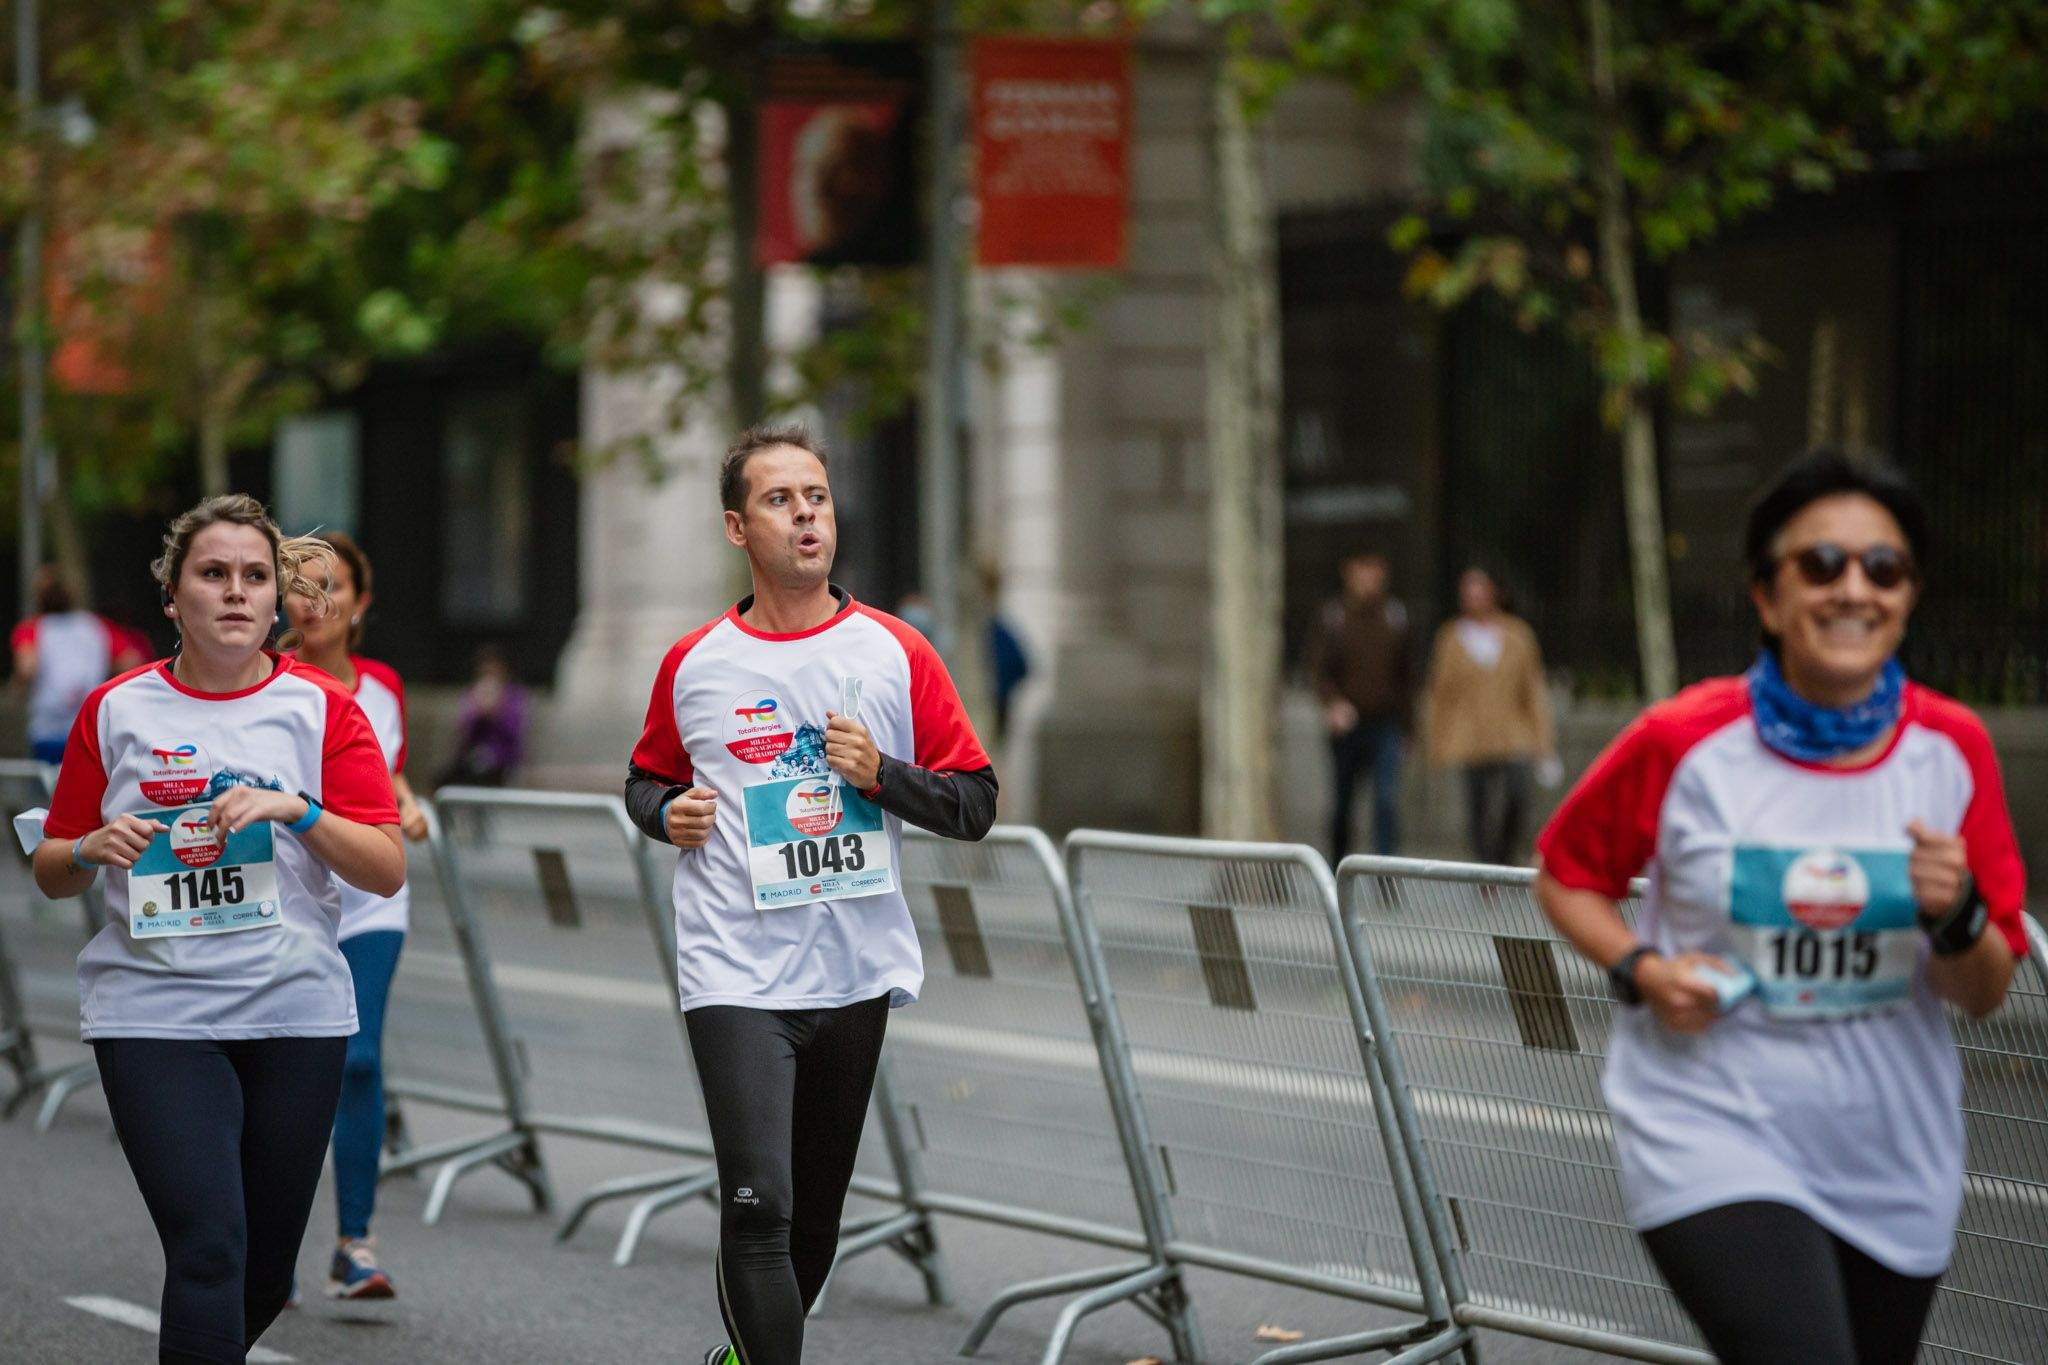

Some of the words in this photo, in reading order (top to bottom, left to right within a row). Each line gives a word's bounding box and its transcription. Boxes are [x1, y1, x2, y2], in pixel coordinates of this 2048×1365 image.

[738, 723, 782, 735] TotalEnergies
[736, 742, 786, 755] INTERNACIONAL
[755, 750, 781, 758] MADRID
[152, 768, 197, 776] TotalEnergies
[778, 834, 866, 880] 1043
[164, 866, 244, 911] 1145
[770, 888, 802, 898] MADRID
[147, 920, 181, 928] MADRID
[1771, 933, 1879, 980] 1015
